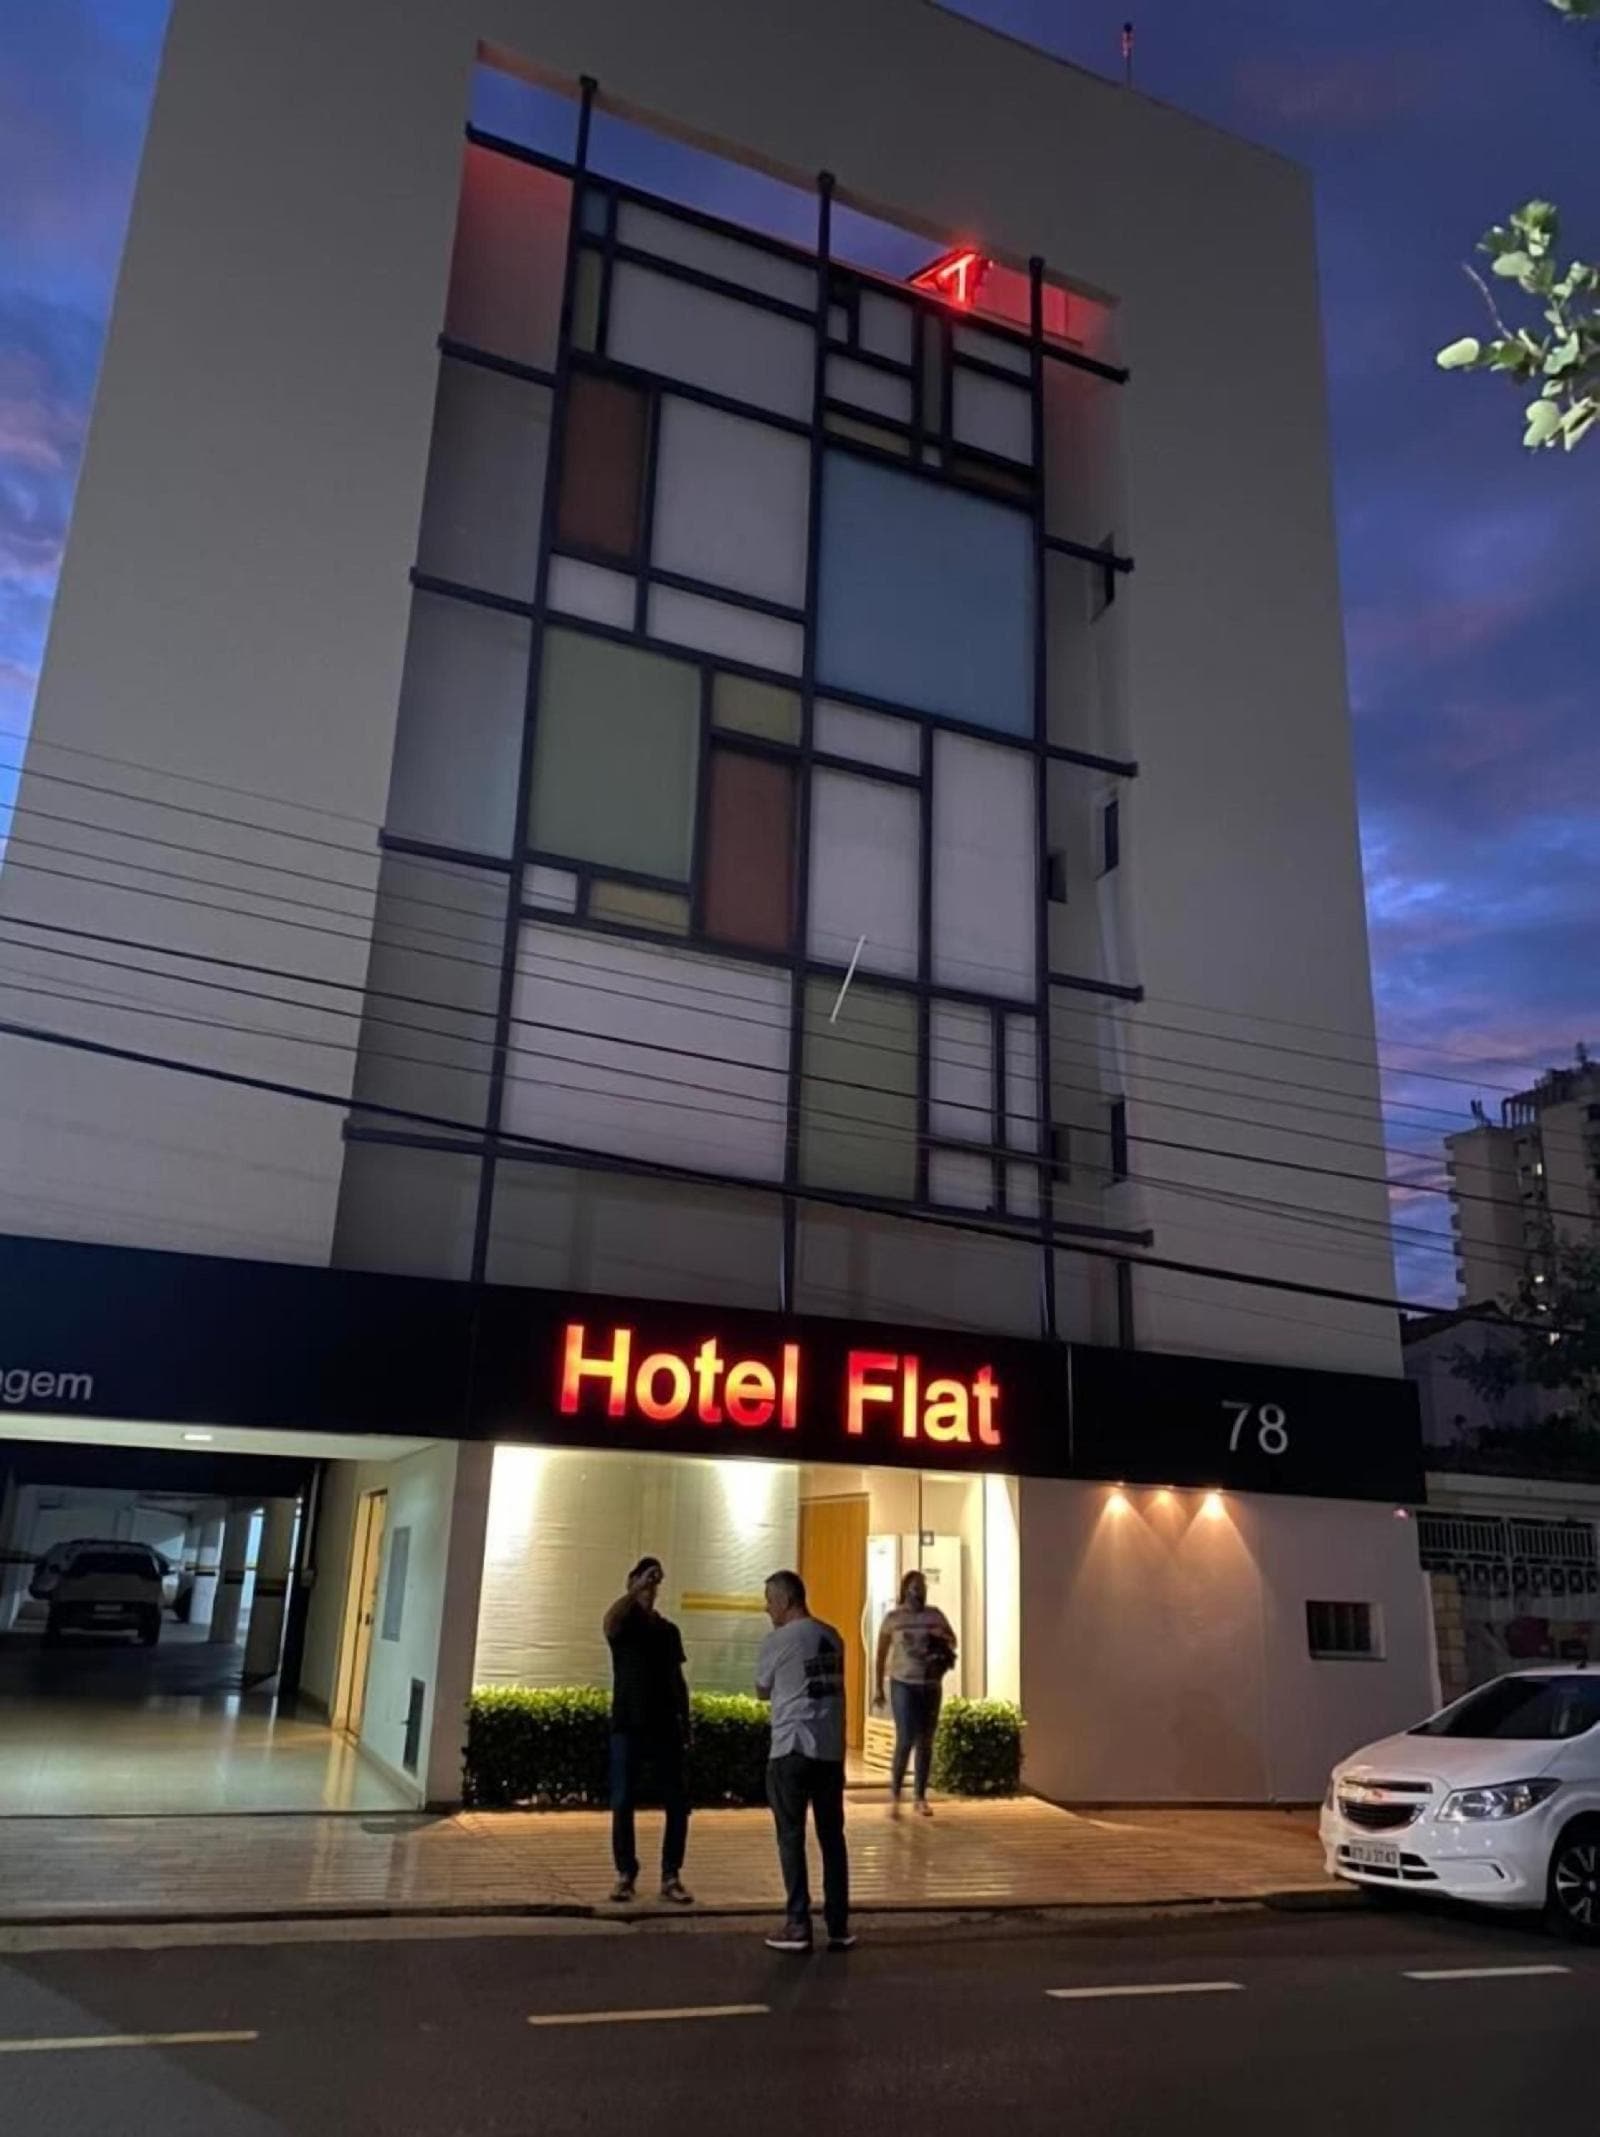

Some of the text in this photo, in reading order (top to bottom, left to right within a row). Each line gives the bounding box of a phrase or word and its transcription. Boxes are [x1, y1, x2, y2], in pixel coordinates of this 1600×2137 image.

[0, 1368, 94, 1403] gem
[560, 1324, 1001, 1445] Hotel Flat
[1221, 1400, 1288, 1454] 78
